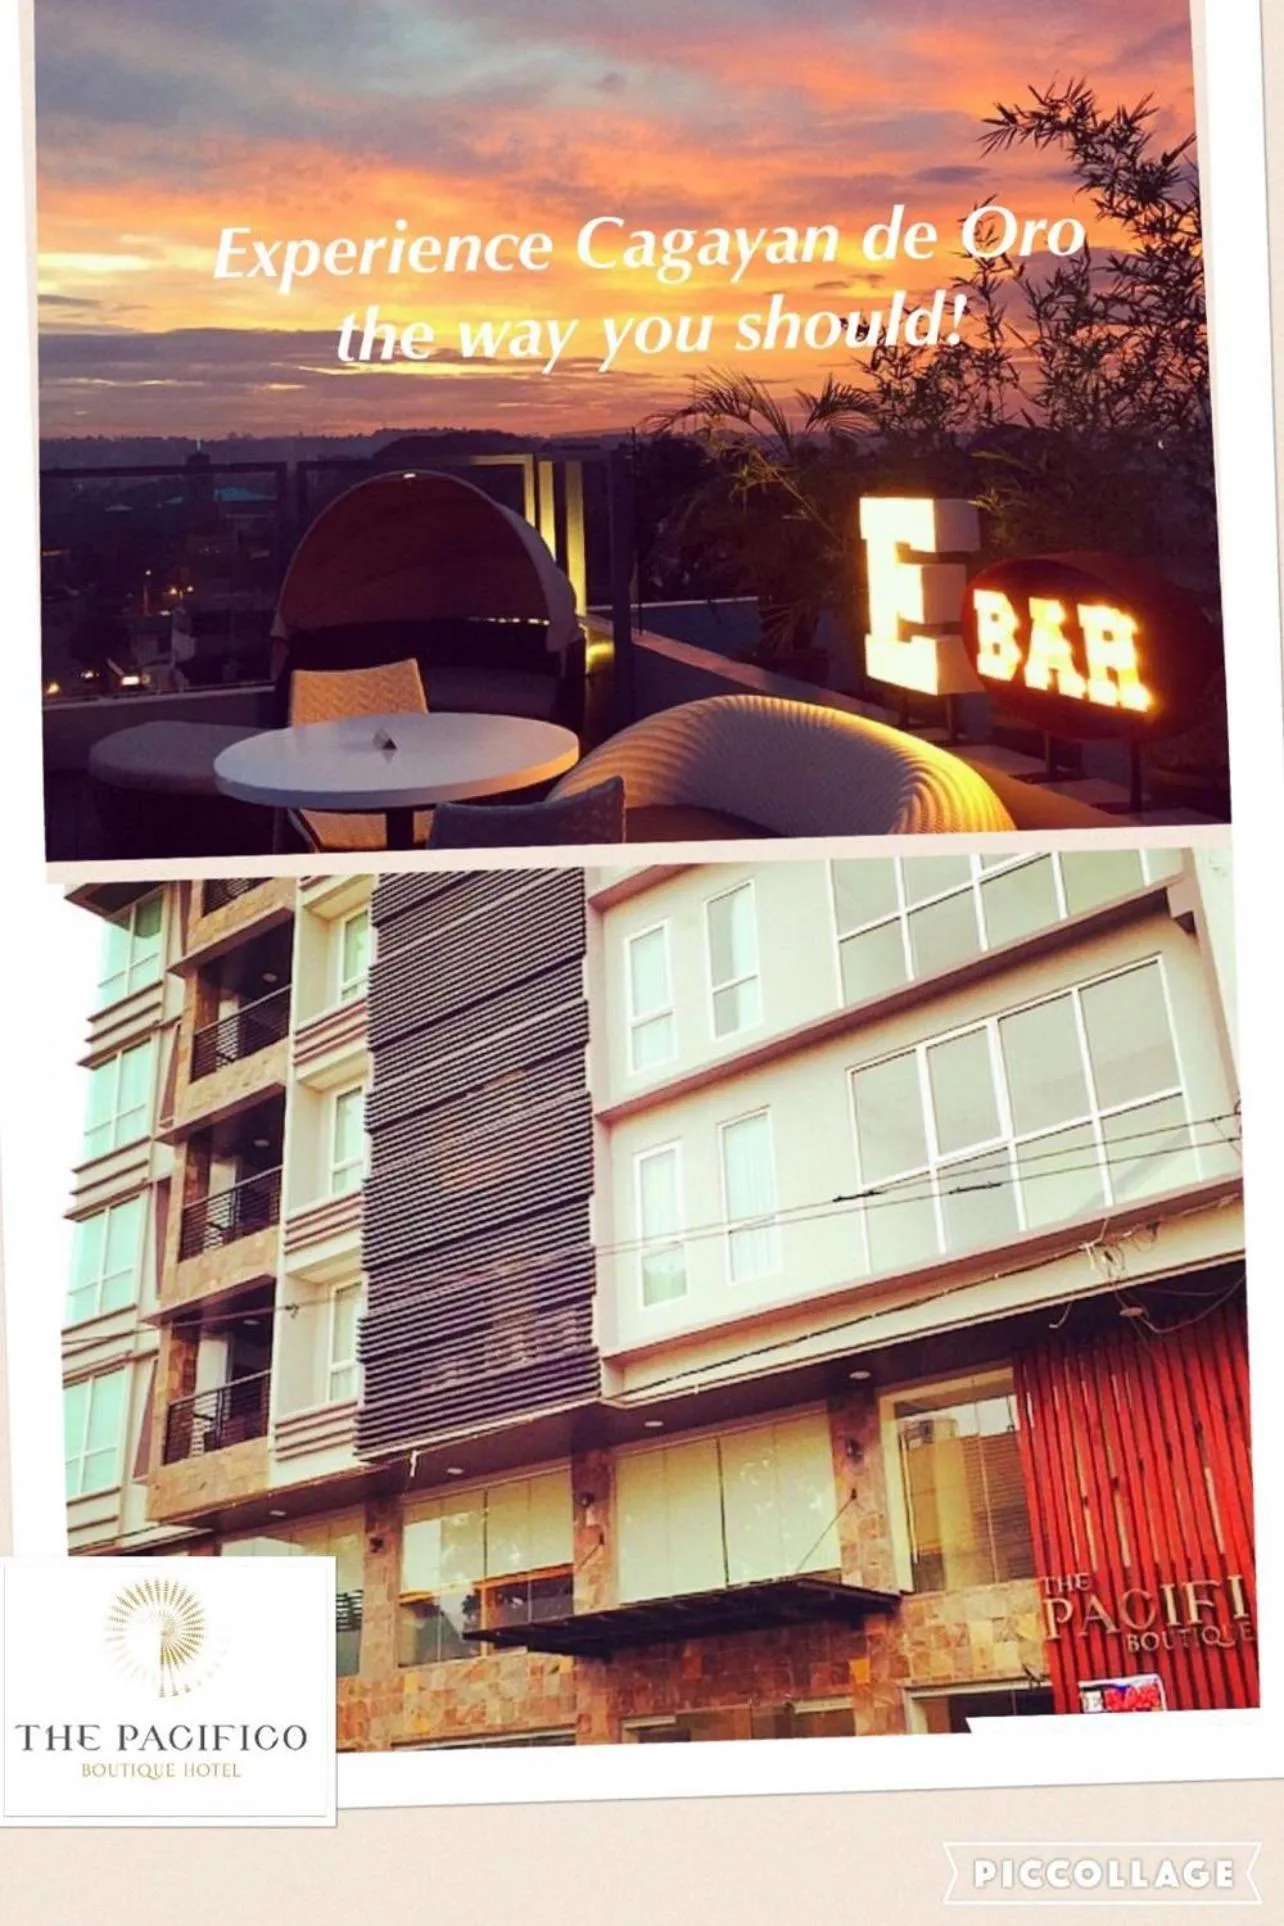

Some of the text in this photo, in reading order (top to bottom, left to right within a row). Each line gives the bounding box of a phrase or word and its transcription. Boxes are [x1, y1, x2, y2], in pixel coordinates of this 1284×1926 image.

[859, 496, 1154, 713] E BAR
[1042, 1572, 1092, 1595] THE
[1127, 1621, 1256, 1652] BOUTIQUE
